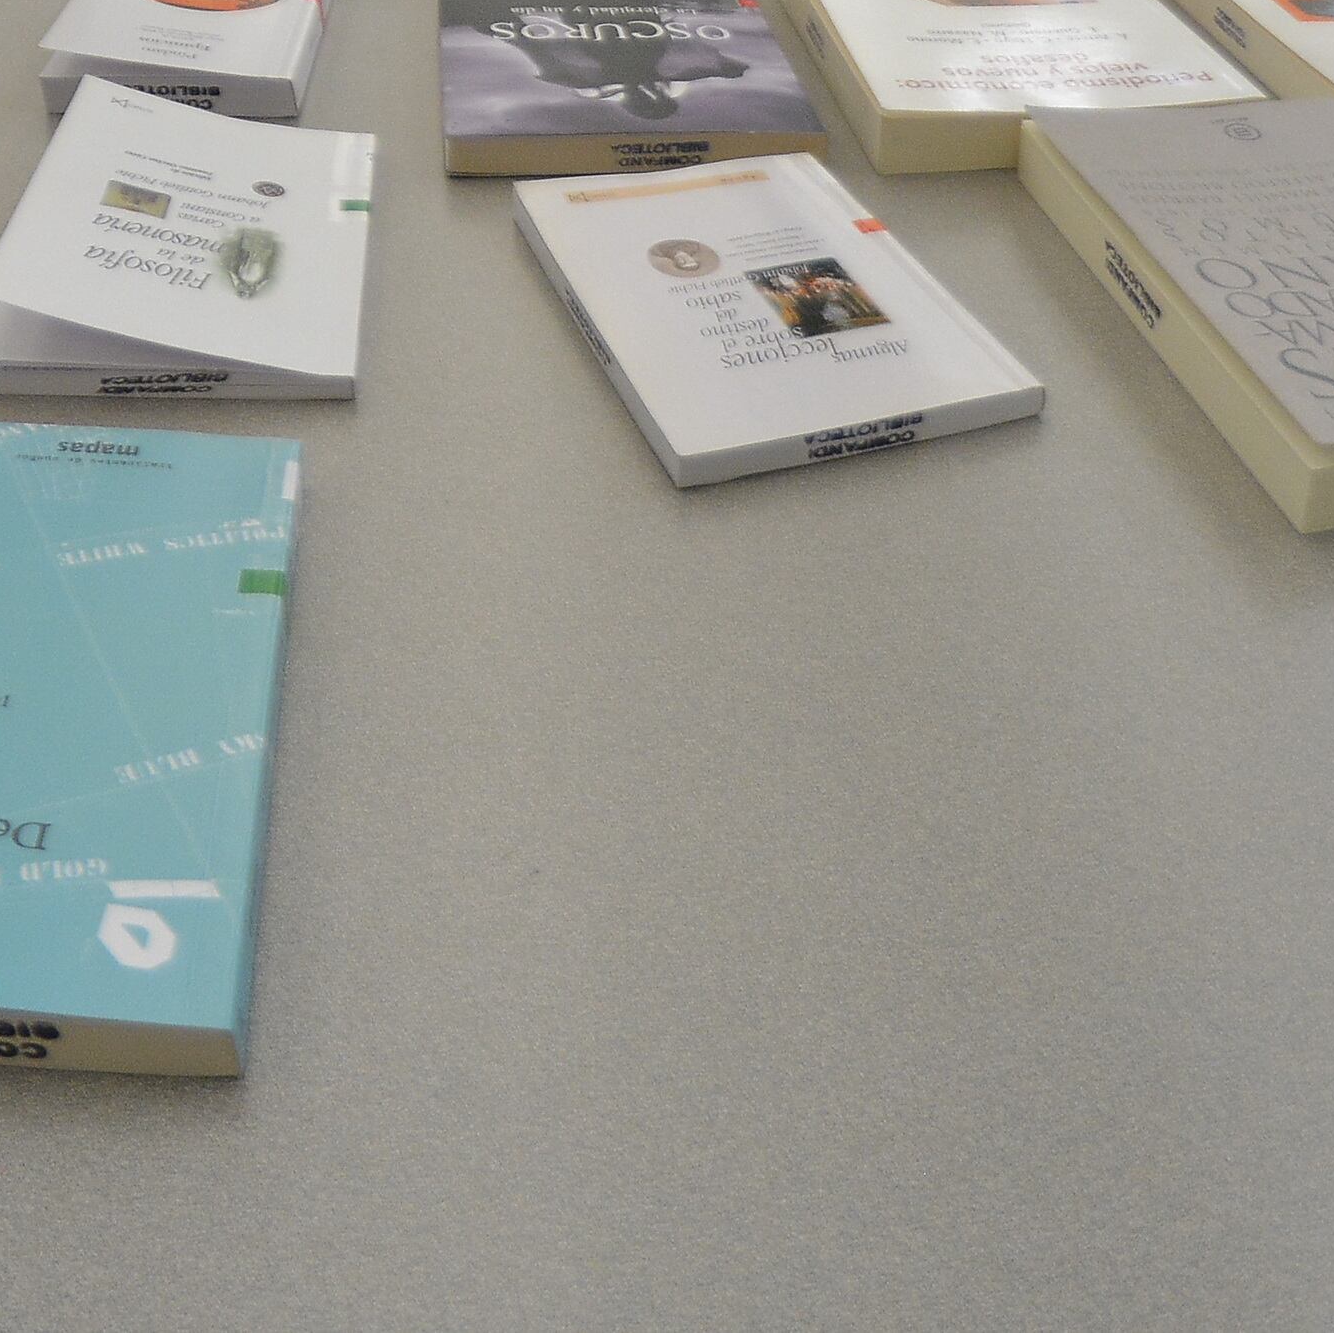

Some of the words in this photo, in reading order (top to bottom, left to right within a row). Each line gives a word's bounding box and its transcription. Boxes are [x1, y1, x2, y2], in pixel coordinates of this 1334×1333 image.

[509, 5, 537, 18] día
[541, 5, 565, 15] un
[586, 5, 668, 18] eternidad
[487, 15, 730, 42] OSCUROS
[940, 66, 1039, 78] nuevos
[1062, 70, 1213, 91] Periodismo
[611, 140, 710, 155] BIBLIOTECA
[90, 212, 225, 255] masonería
[156, 247, 177, 262] la
[181, 253, 205, 267] de
[82, 243, 211, 292] Filosofía
[1103, 239, 1163, 320] BIBLIOTECA
[684, 290, 742, 309] sabio
[713, 307, 737, 322] del
[699, 316, 768, 339] destino
[744, 326, 802, 349] sobre
[719, 337, 837, 370] lecciones
[720, 337, 737, 352] el
[829, 337, 909, 364] Algunas
[98, 371, 229, 387] BIBLIOTECA
[803, 413, 924, 444] BIBLIOTECA
[55, 439, 141, 460] mapas
[113, 746, 201, 785] BLUE
[16, 855, 109, 883] GOLD
